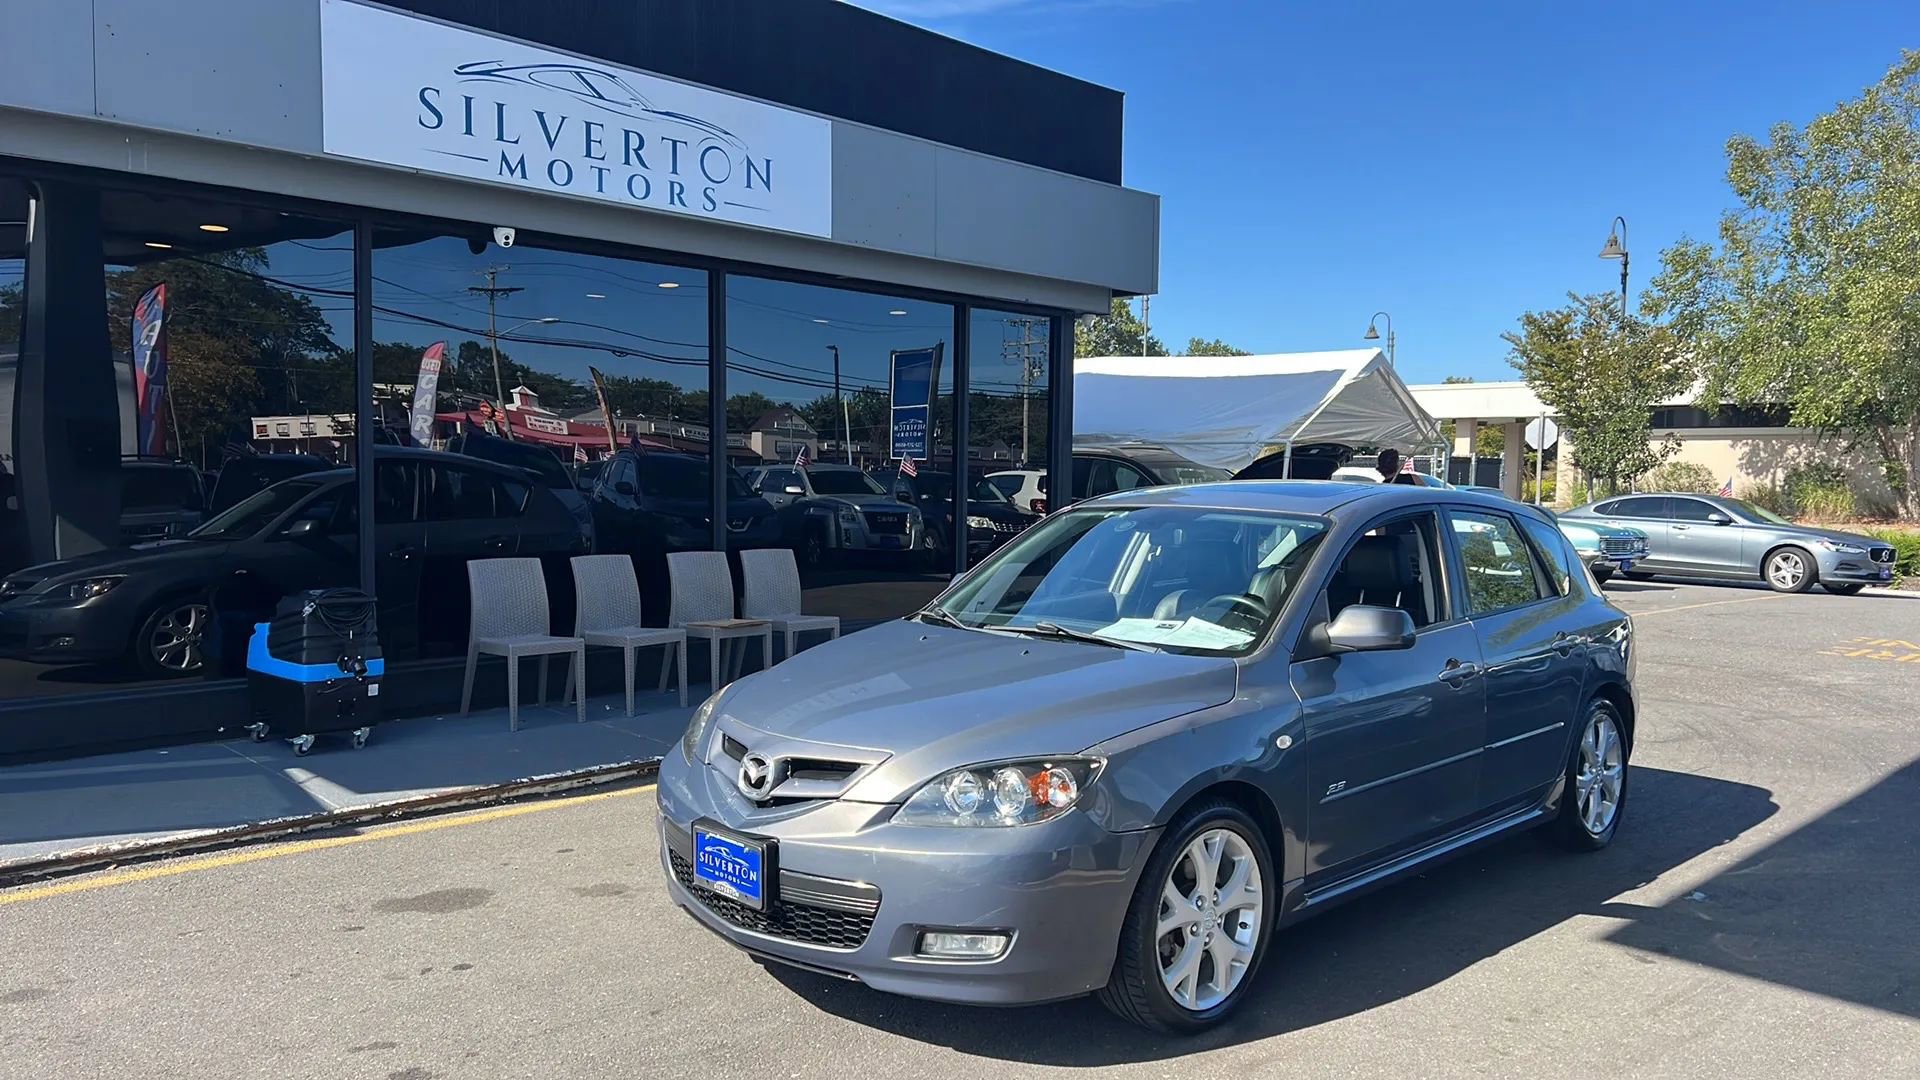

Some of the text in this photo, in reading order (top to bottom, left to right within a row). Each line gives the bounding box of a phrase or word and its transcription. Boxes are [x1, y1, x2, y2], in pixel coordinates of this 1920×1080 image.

[417, 86, 774, 193] SILVERTON
[497, 149, 719, 213] MOTORS
[699, 851, 757, 882] SILVERTON
[714, 870, 741, 884] MOTORS
